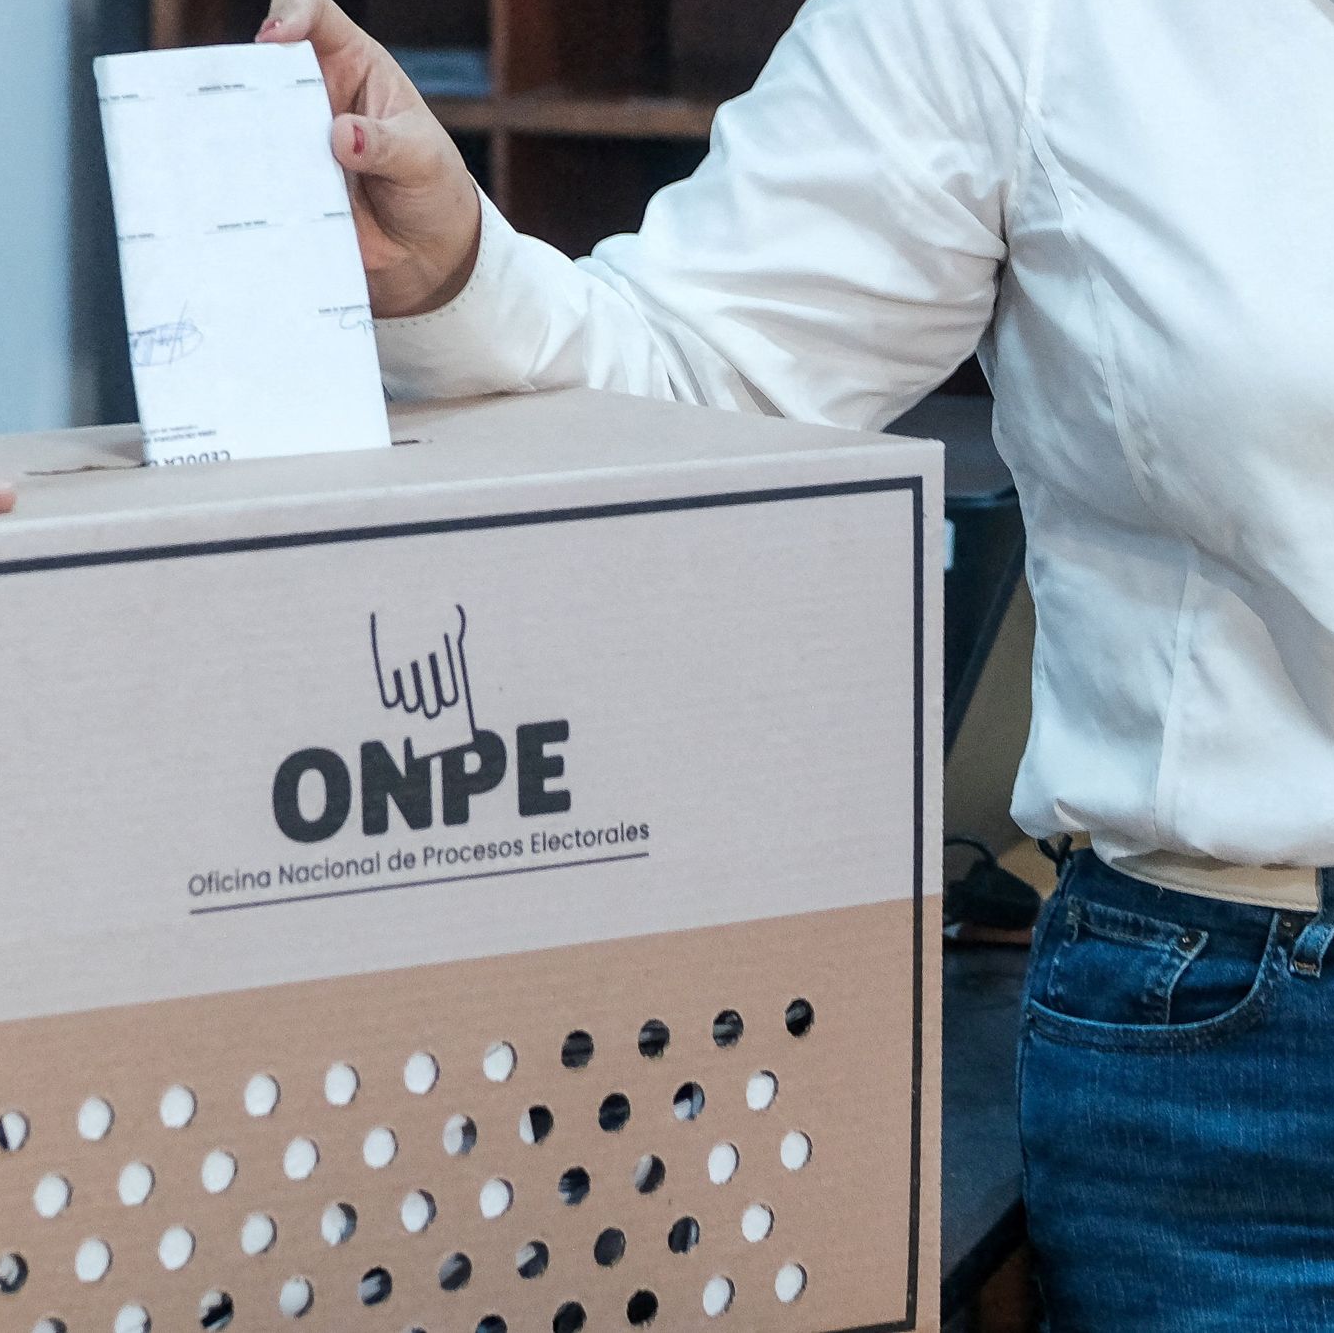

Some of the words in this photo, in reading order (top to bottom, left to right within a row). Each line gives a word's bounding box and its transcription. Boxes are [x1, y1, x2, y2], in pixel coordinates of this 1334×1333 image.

[272, 719, 571, 844] ONPE
[187, 870, 272, 897] Oficina
[278, 853, 382, 886] Nacional
[386, 848, 417, 872] de
[423, 838, 524, 869] Procesos
[530, 820, 651, 855] Electorales
